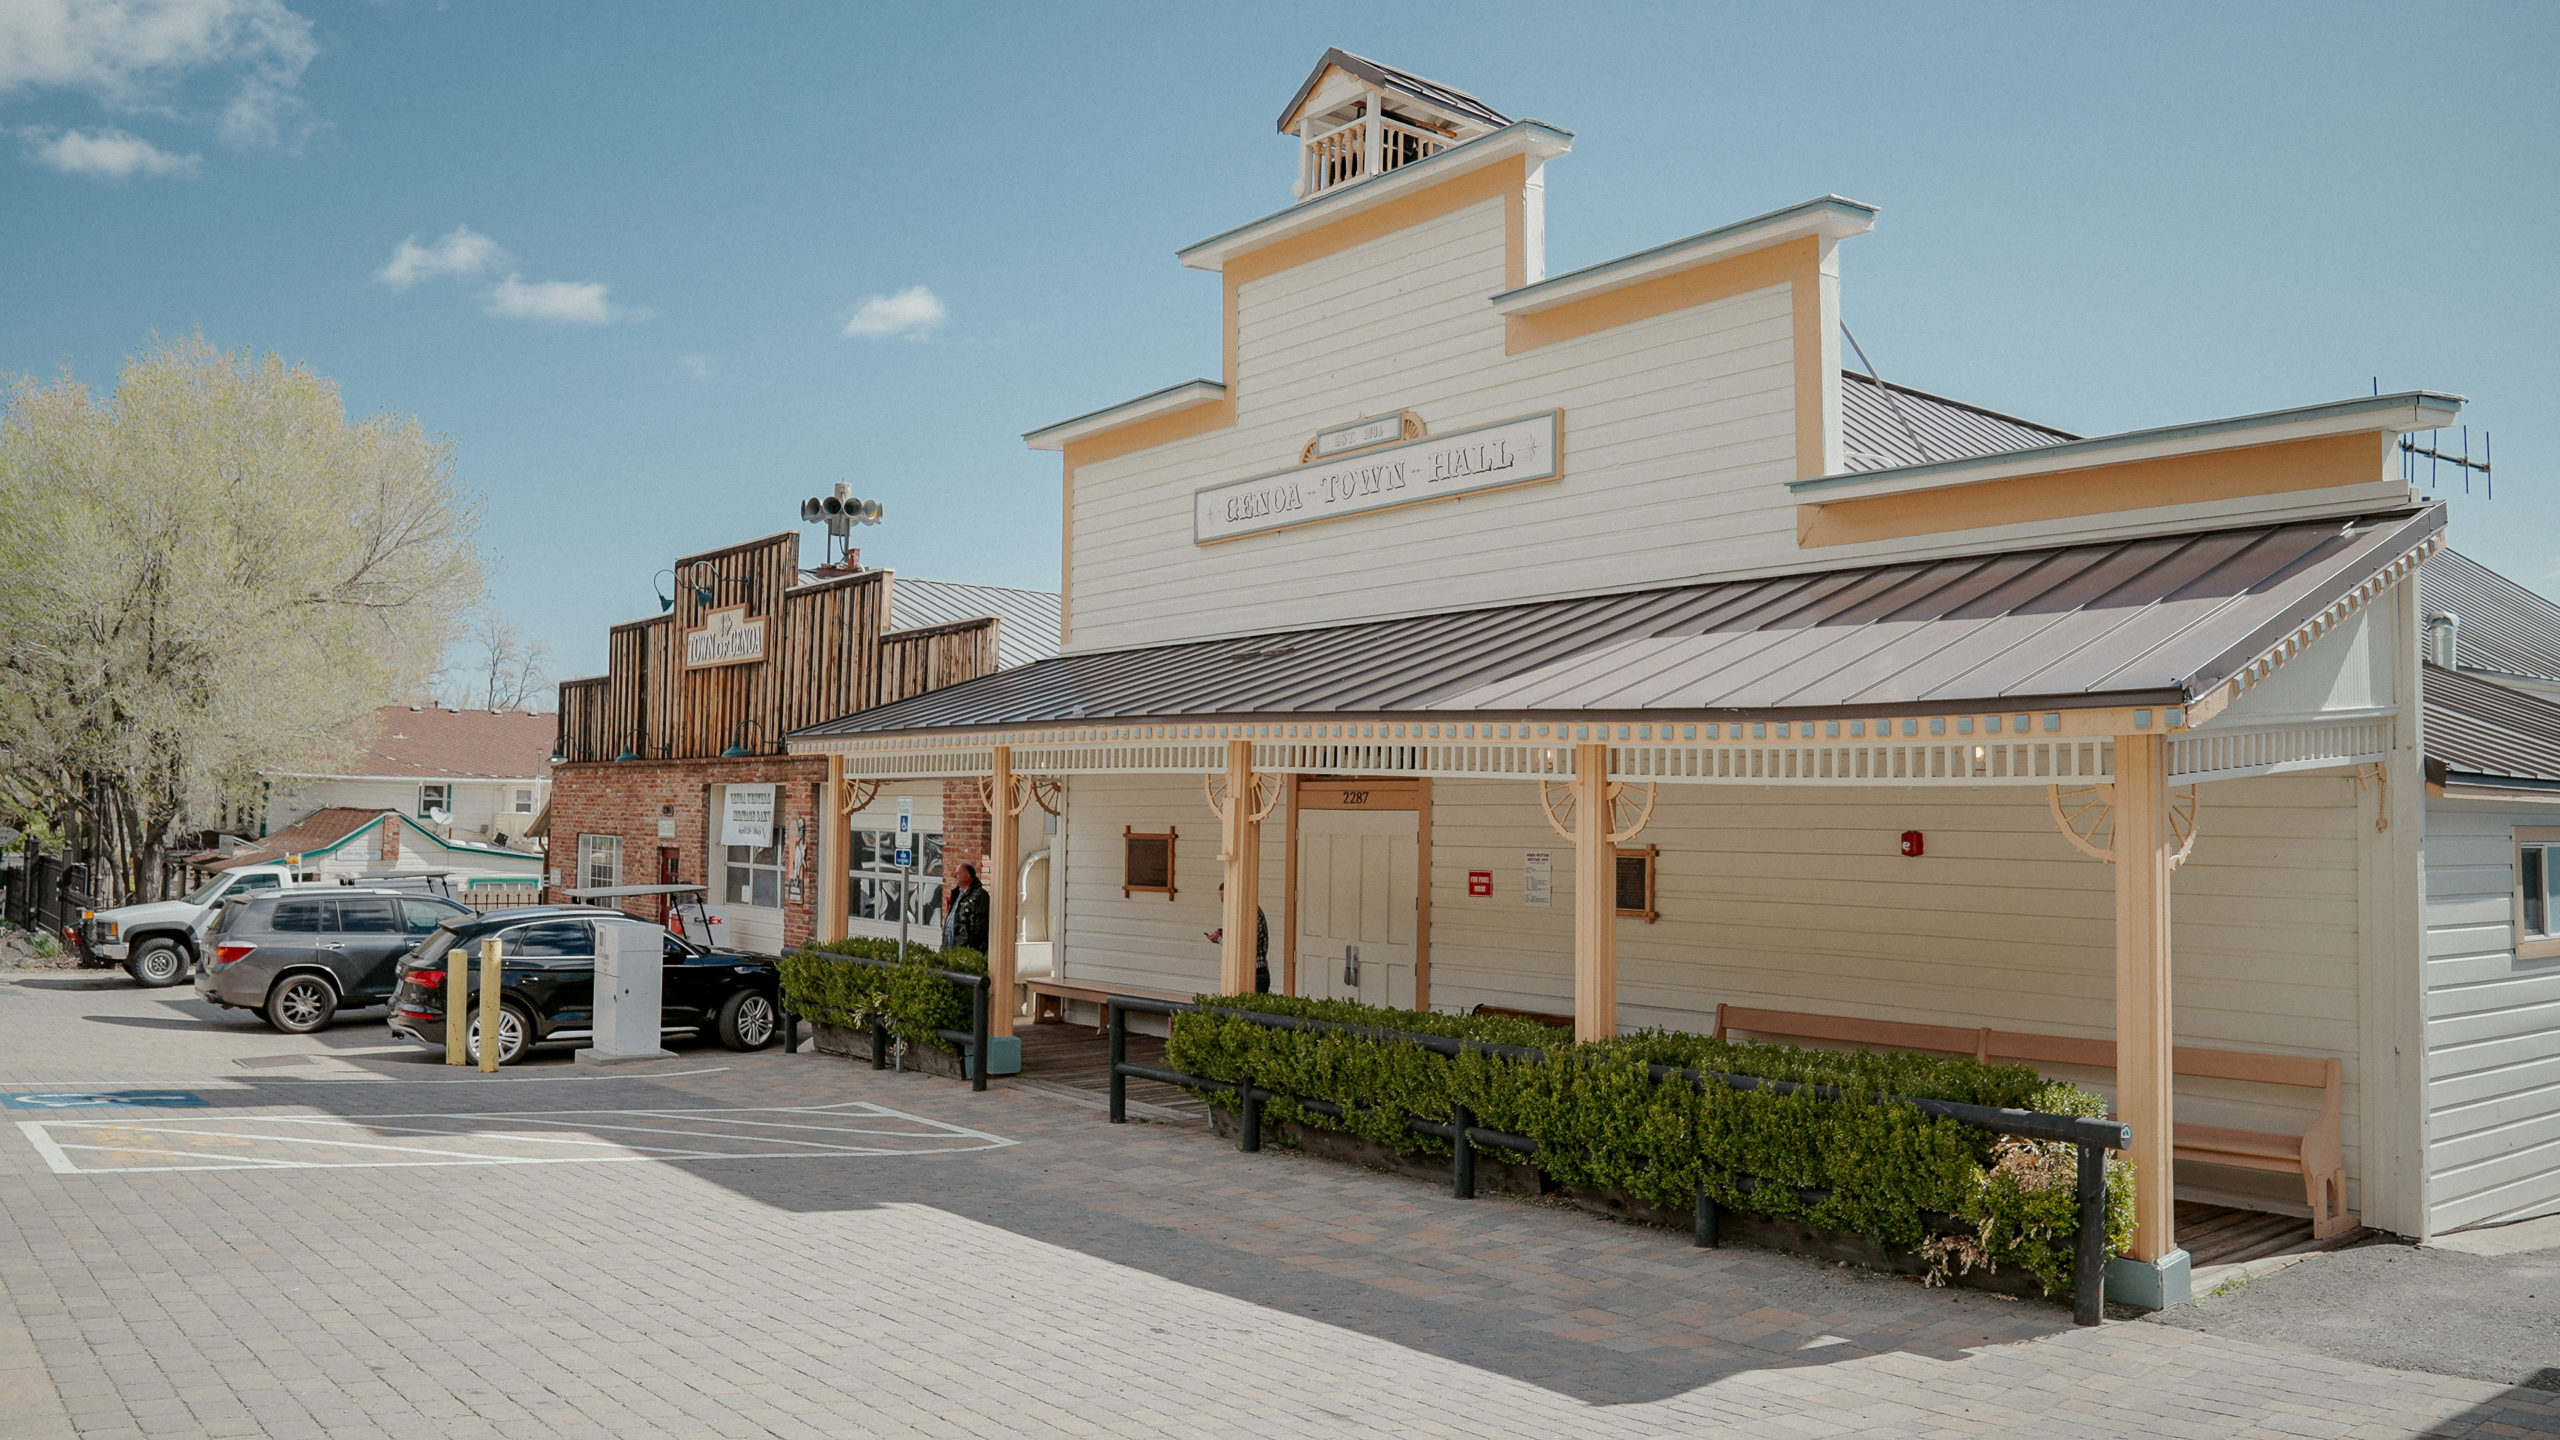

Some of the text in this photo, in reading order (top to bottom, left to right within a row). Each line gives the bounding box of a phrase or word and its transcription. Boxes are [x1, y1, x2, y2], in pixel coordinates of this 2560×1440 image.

[1225, 439, 1515, 523] GENOA TOWN HALL
[688, 633, 716, 662] TOWN
[730, 625, 762, 657] GENOA
[1343, 791, 1369, 805] 2287
[694, 915, 724, 925] FeEx
